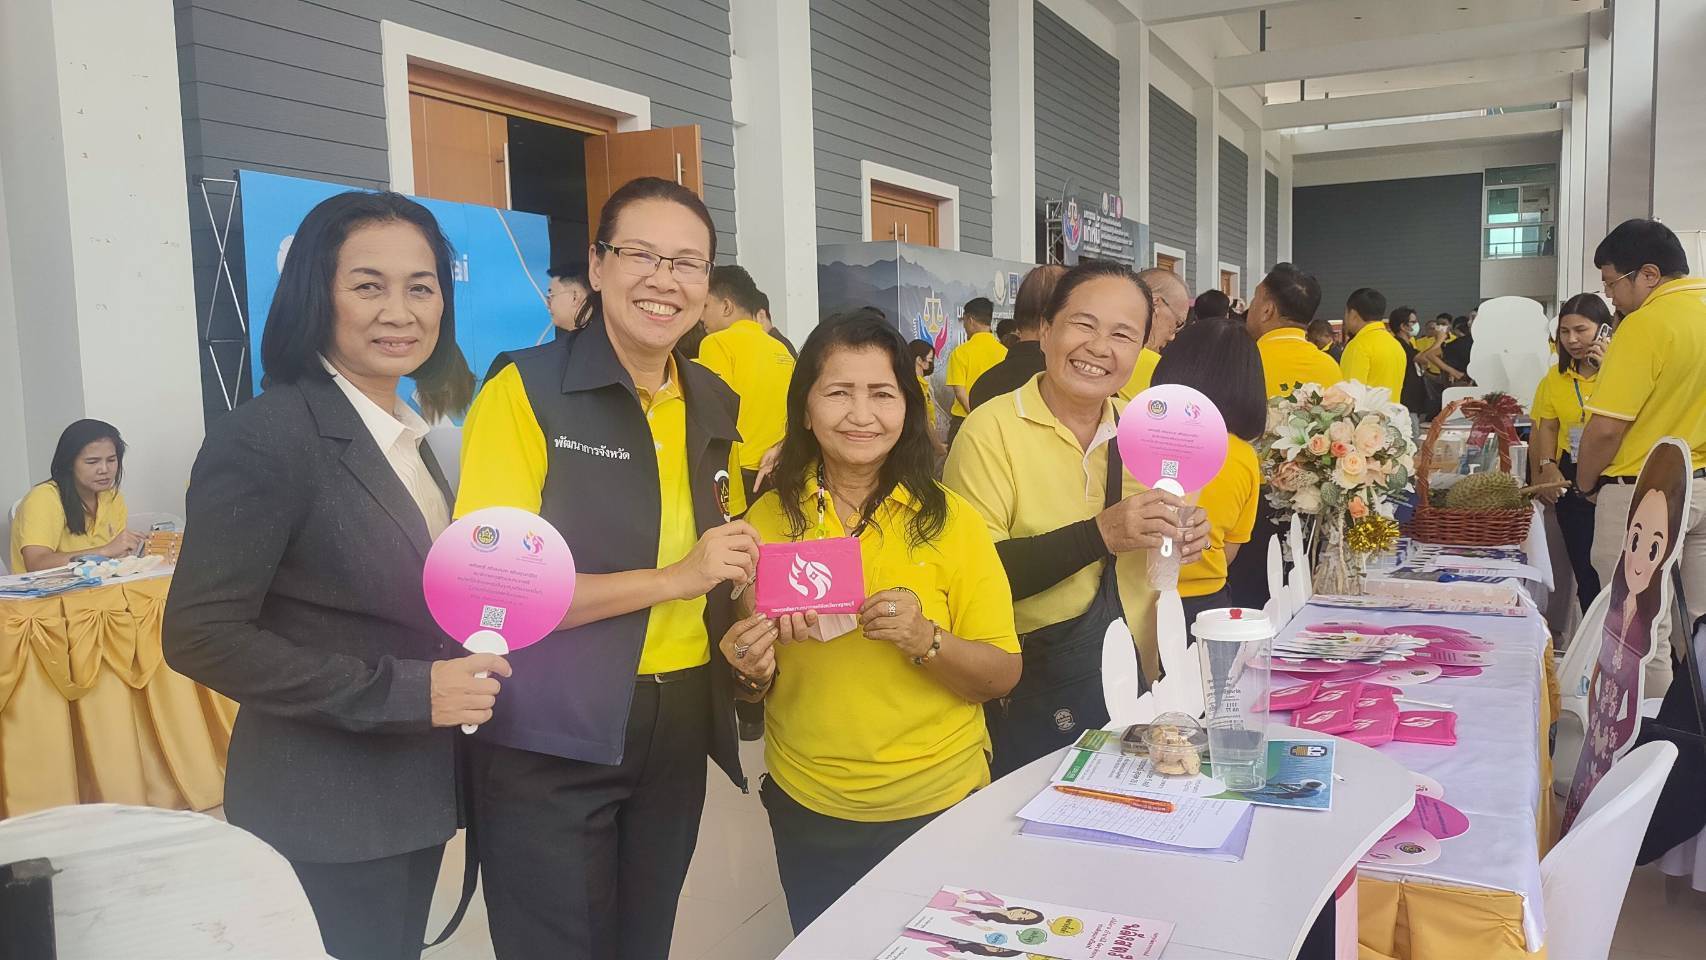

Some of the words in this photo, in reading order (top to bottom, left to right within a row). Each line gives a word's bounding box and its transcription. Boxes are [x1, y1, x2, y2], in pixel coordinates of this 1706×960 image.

[554, 435, 631, 460] พัฒนาการจังหวัด
[1107, 923, 1146, 959] พลังสตรี
